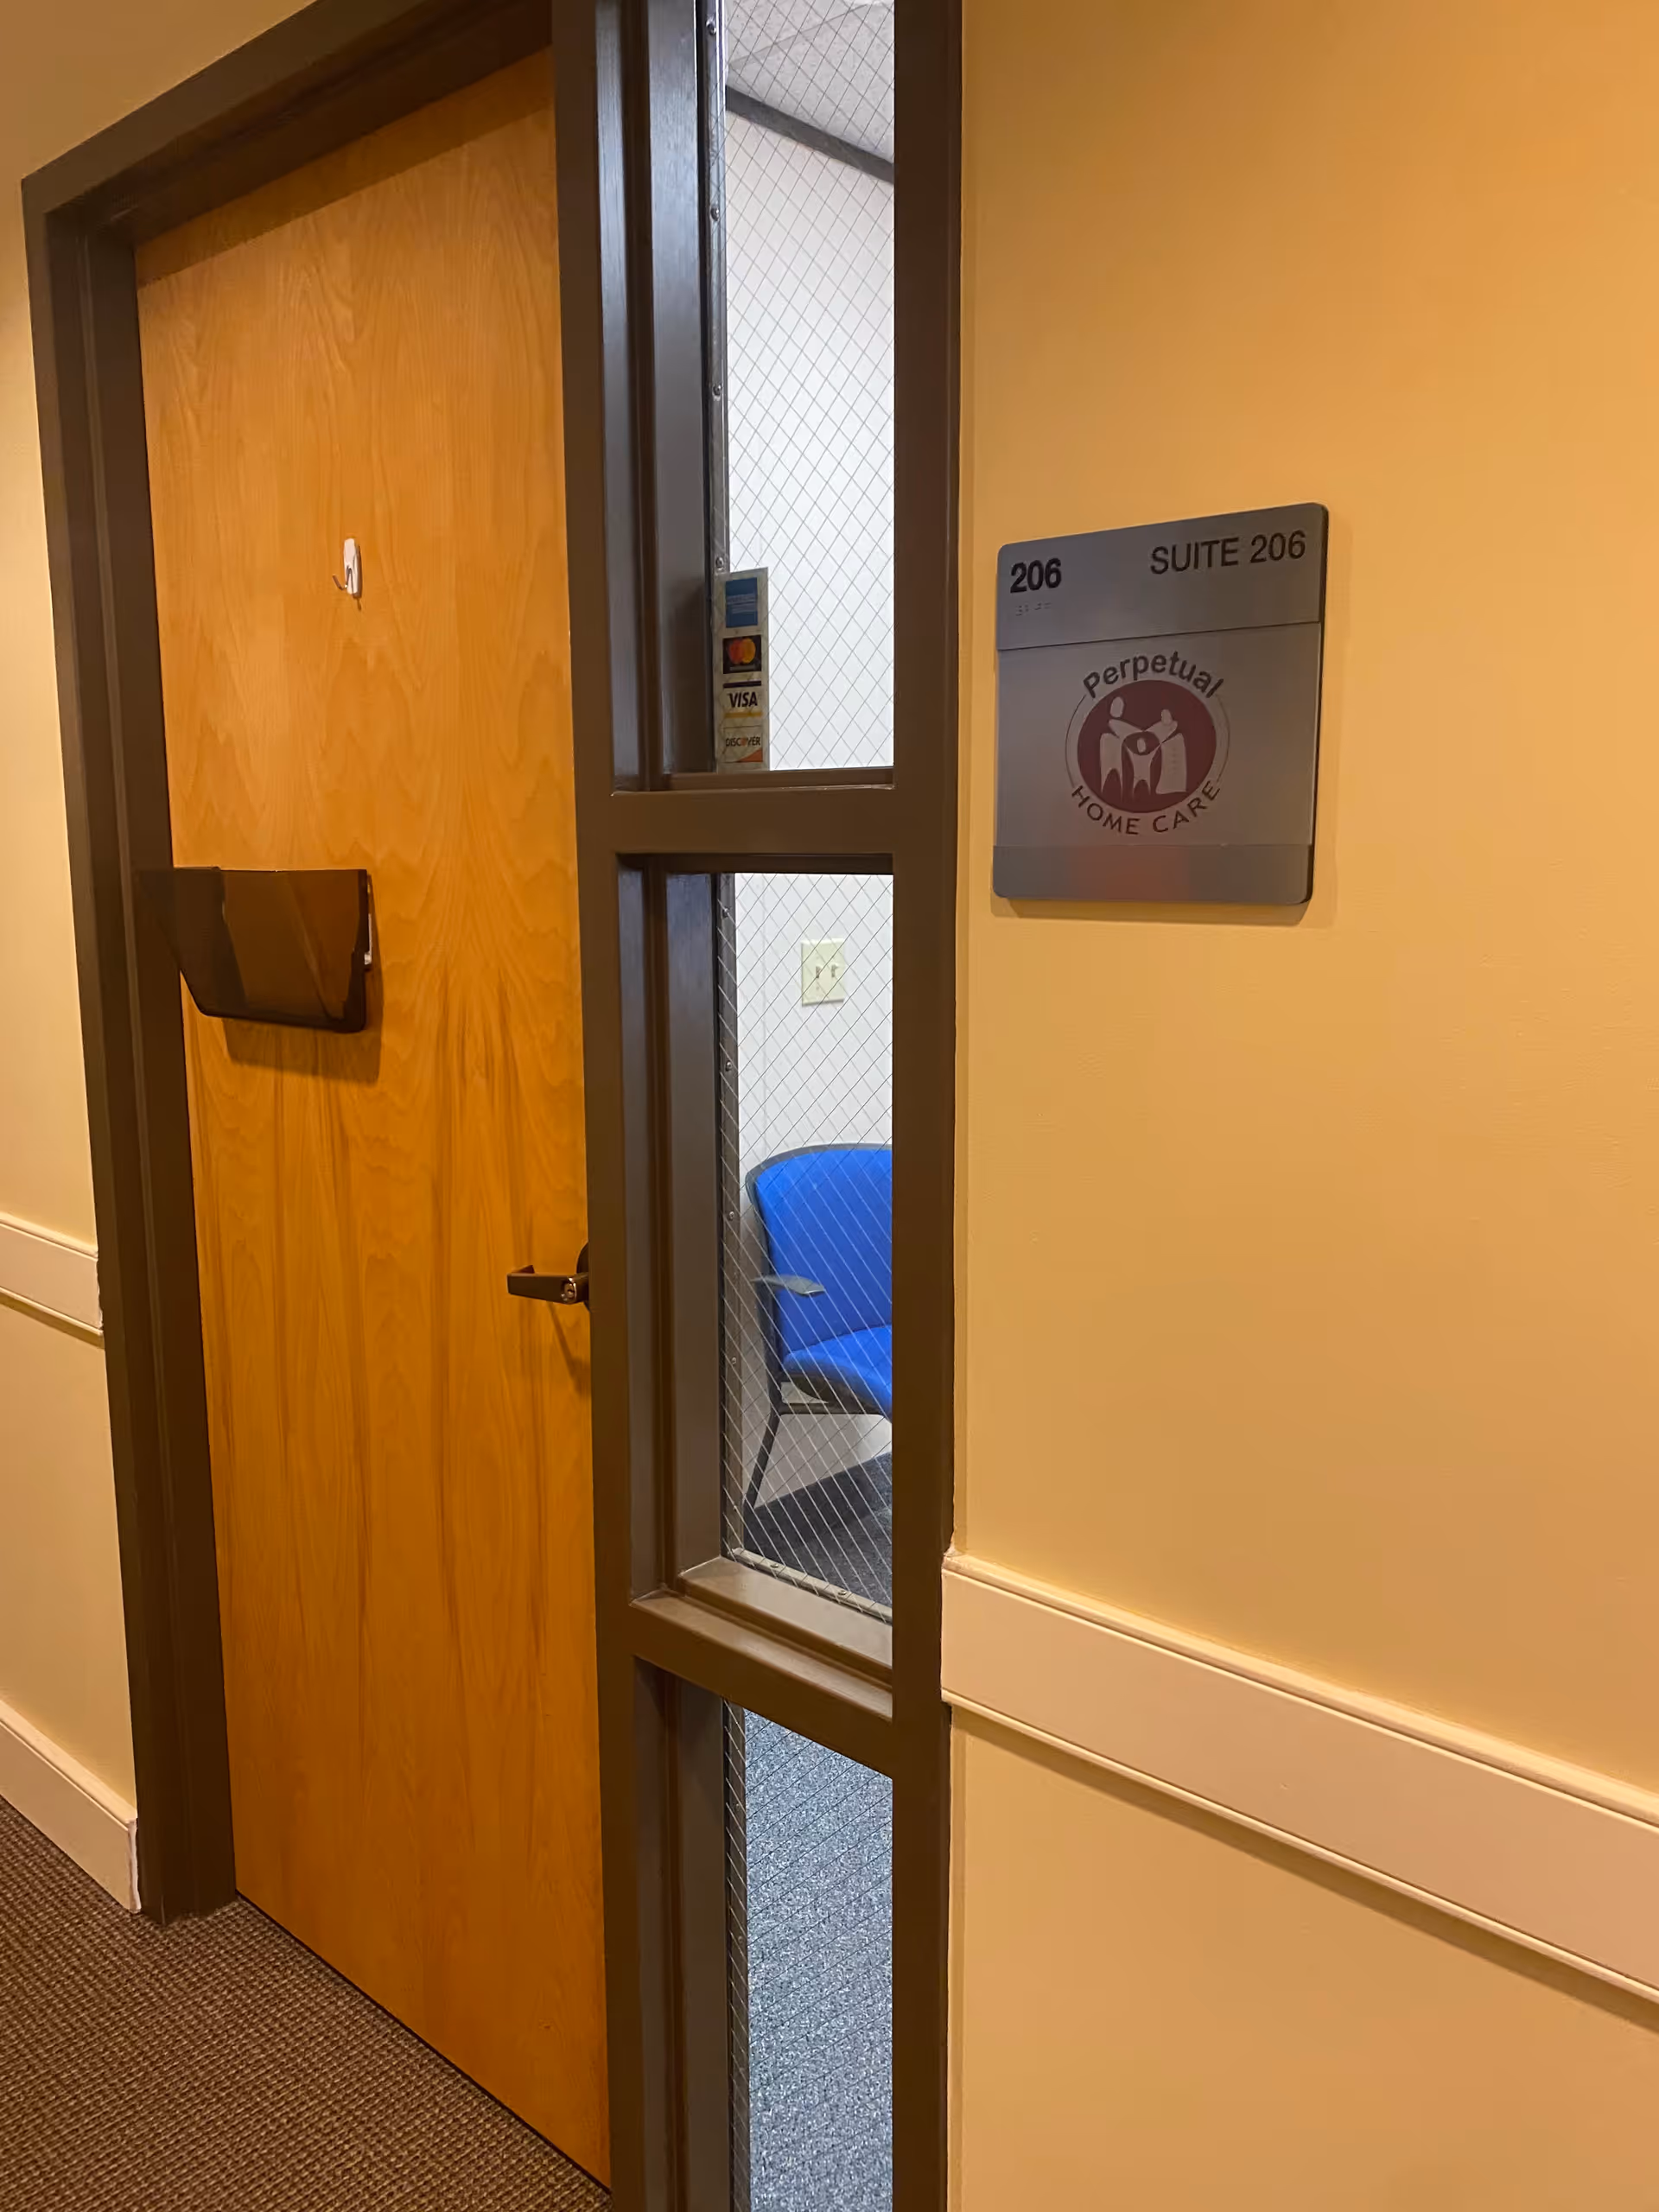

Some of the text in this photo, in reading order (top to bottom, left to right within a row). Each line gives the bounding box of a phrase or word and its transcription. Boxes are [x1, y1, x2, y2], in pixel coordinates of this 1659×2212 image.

[1150, 530, 1306, 575] SUITE 206
[1010, 557, 1062, 594] 206
[1083, 651, 1224, 698] Perpetual
[728, 691, 758, 708] VISA
[726, 736, 761, 747] DISCOVER
[1071, 780, 1220, 835] HOME CARE
